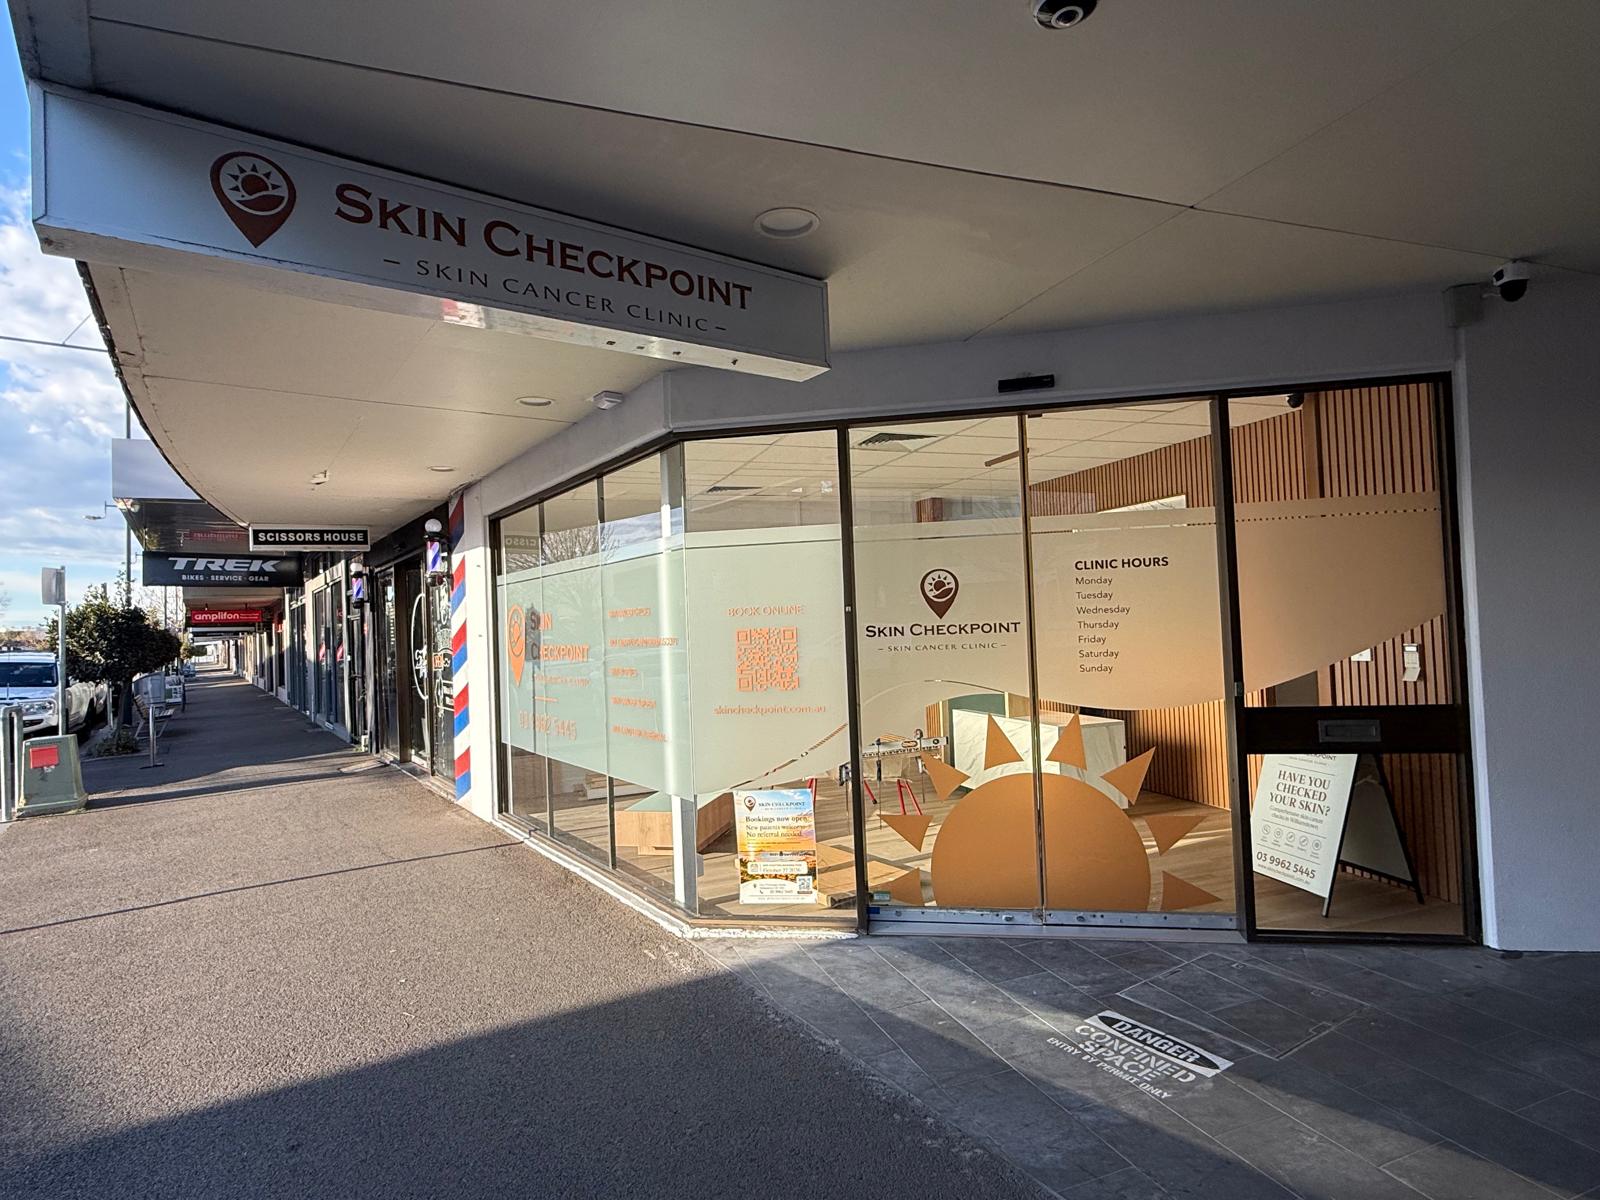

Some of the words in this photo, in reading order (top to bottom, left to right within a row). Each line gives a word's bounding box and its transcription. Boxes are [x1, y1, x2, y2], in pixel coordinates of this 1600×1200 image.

[416, 259, 489, 288] SKIN
[503, 278, 615, 312] CANCER
[627, 304, 709, 332] CLINIC
[258, 532, 321, 542] SCISSORS
[323, 532, 364, 542] HOUSE
[168, 557, 280, 572] TREK
[1075, 559, 1118, 570] CLINIC
[1121, 557, 1169, 568] HOURS
[1075, 577, 1113, 586] Monday
[1076, 591, 1113, 600] Tuesday
[194, 611, 240, 622] amplifon
[728, 606, 760, 617] BOOK
[763, 605, 807, 616] ONLINE
[1076, 605, 1131, 615] Wednesday
[1078, 620, 1119, 629] Thursday
[1078, 635, 1107, 645] Friday
[1079, 649, 1119, 659] Saturday
[1080, 664, 1113, 674] Sunday
[1278, 770, 1306, 784] HAVE
[1308, 776, 1331, 790] YOU
[1276, 782, 1327, 802] CHECKED
[1269, 792, 1297, 808] YOUR
[1298, 800, 1331, 816] SKIN?
[1256, 851, 1267, 862] 03
[1269, 856, 1292, 870] 9962
[1293, 864, 1317, 879] 5445
[1111, 1020, 1202, 1064] DANGER
[1075, 1025, 1197, 1083] CONFINED
[1079, 1040, 1162, 1082] SPACE
[1046, 1037, 1083, 1056] ENTRY
[1082, 1054, 1100, 1064] BY
[1096, 1061, 1141, 1085] PERMIT
[1138, 1082, 1173, 1100] ONLY
